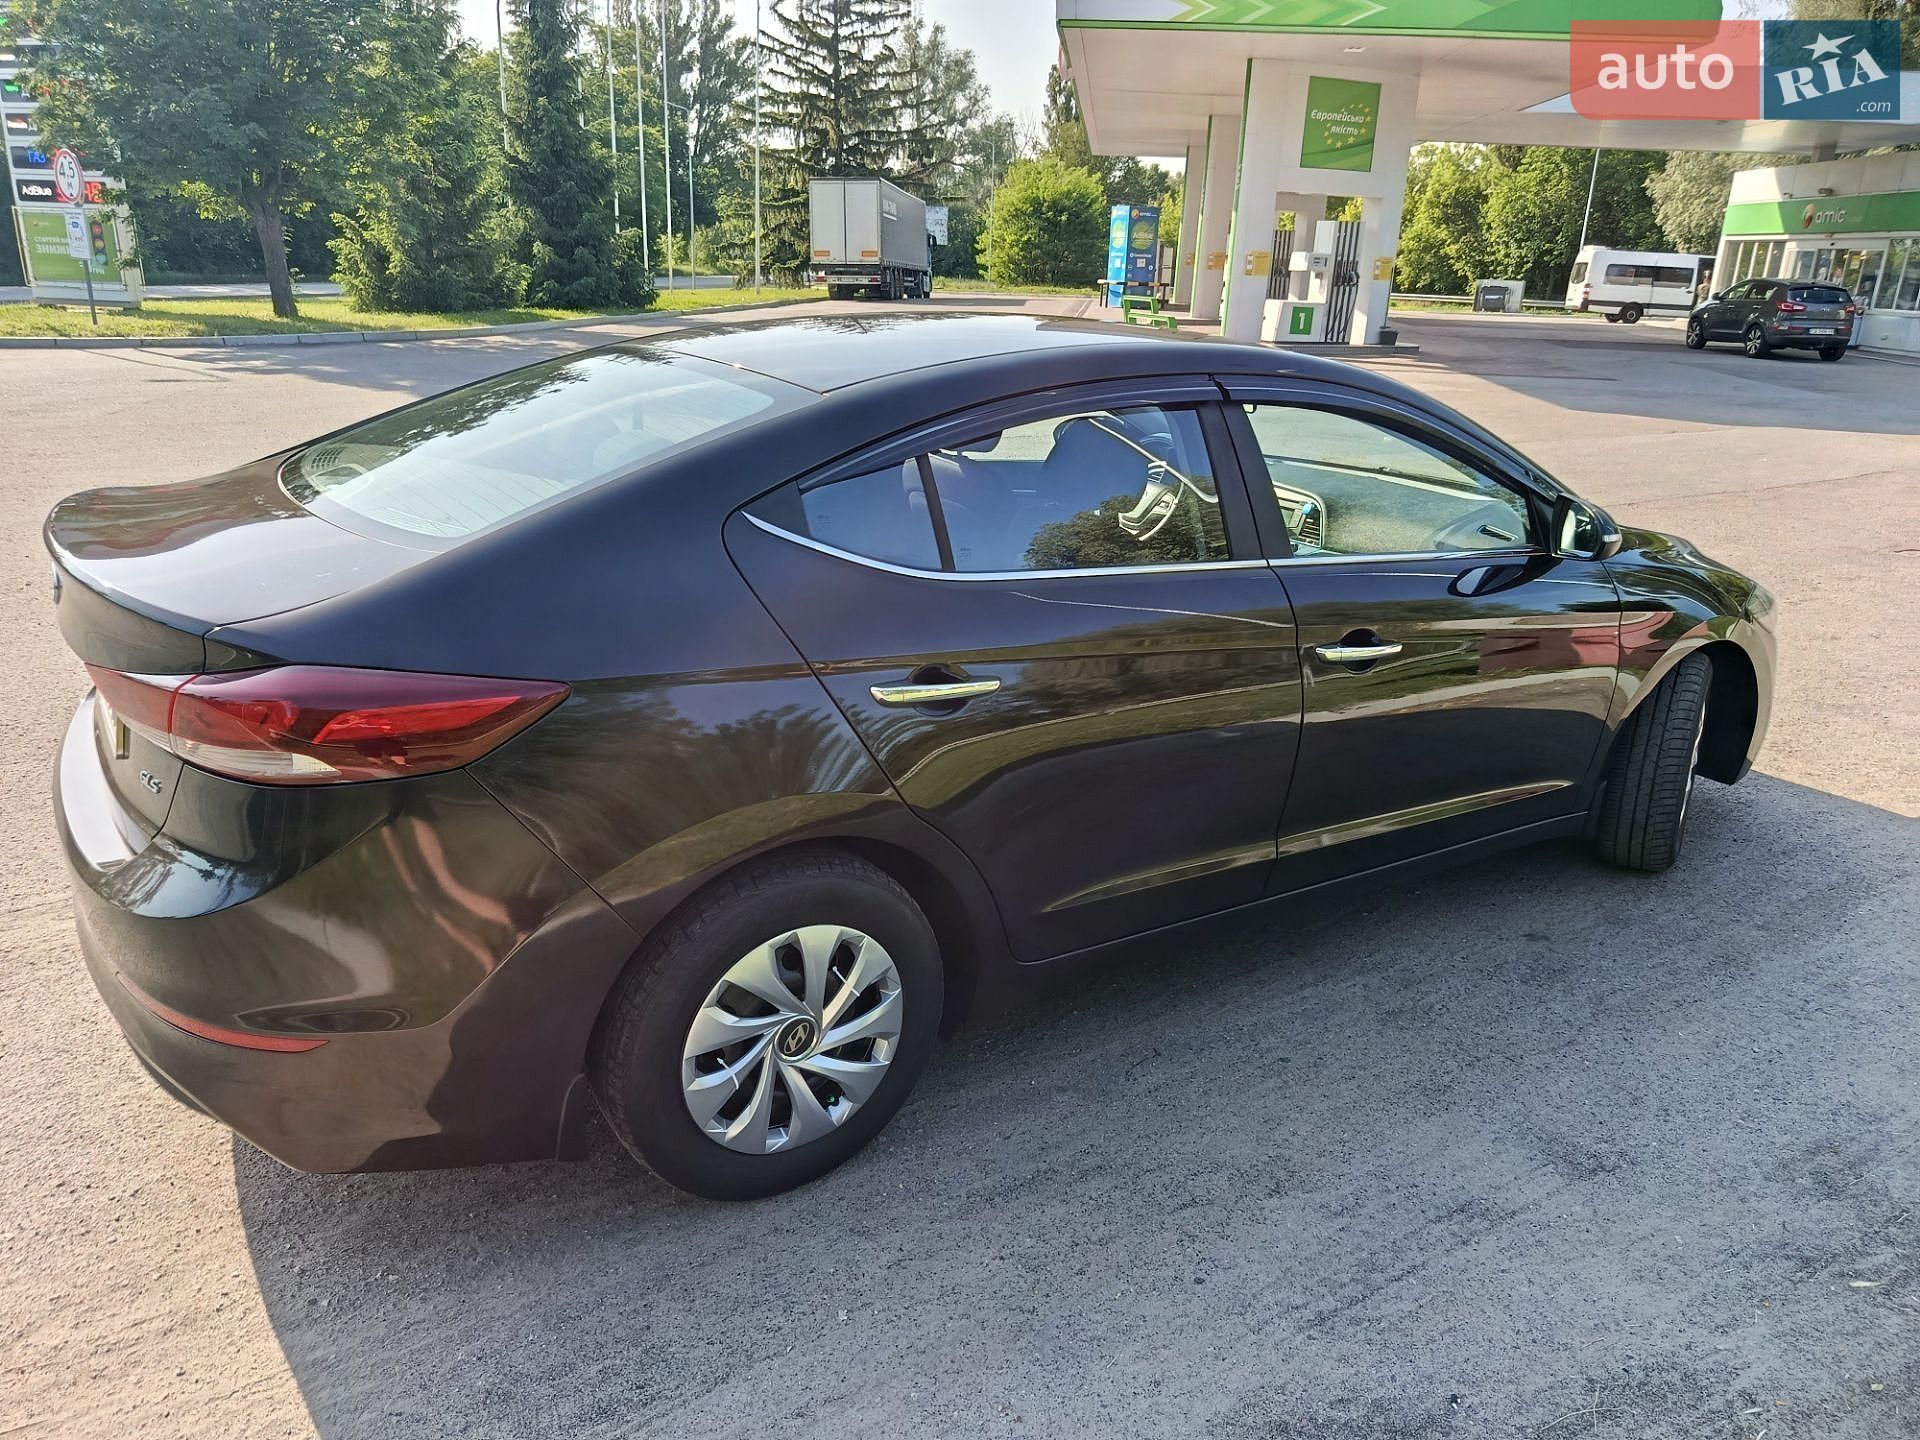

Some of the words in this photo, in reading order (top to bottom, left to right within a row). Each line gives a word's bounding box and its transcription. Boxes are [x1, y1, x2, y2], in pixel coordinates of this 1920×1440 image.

[1330, 124, 1359, 136] якість
[22, 184, 52, 196] AdBlue
[1815, 206, 1847, 224] amic
[1298, 312, 1306, 330] 1
